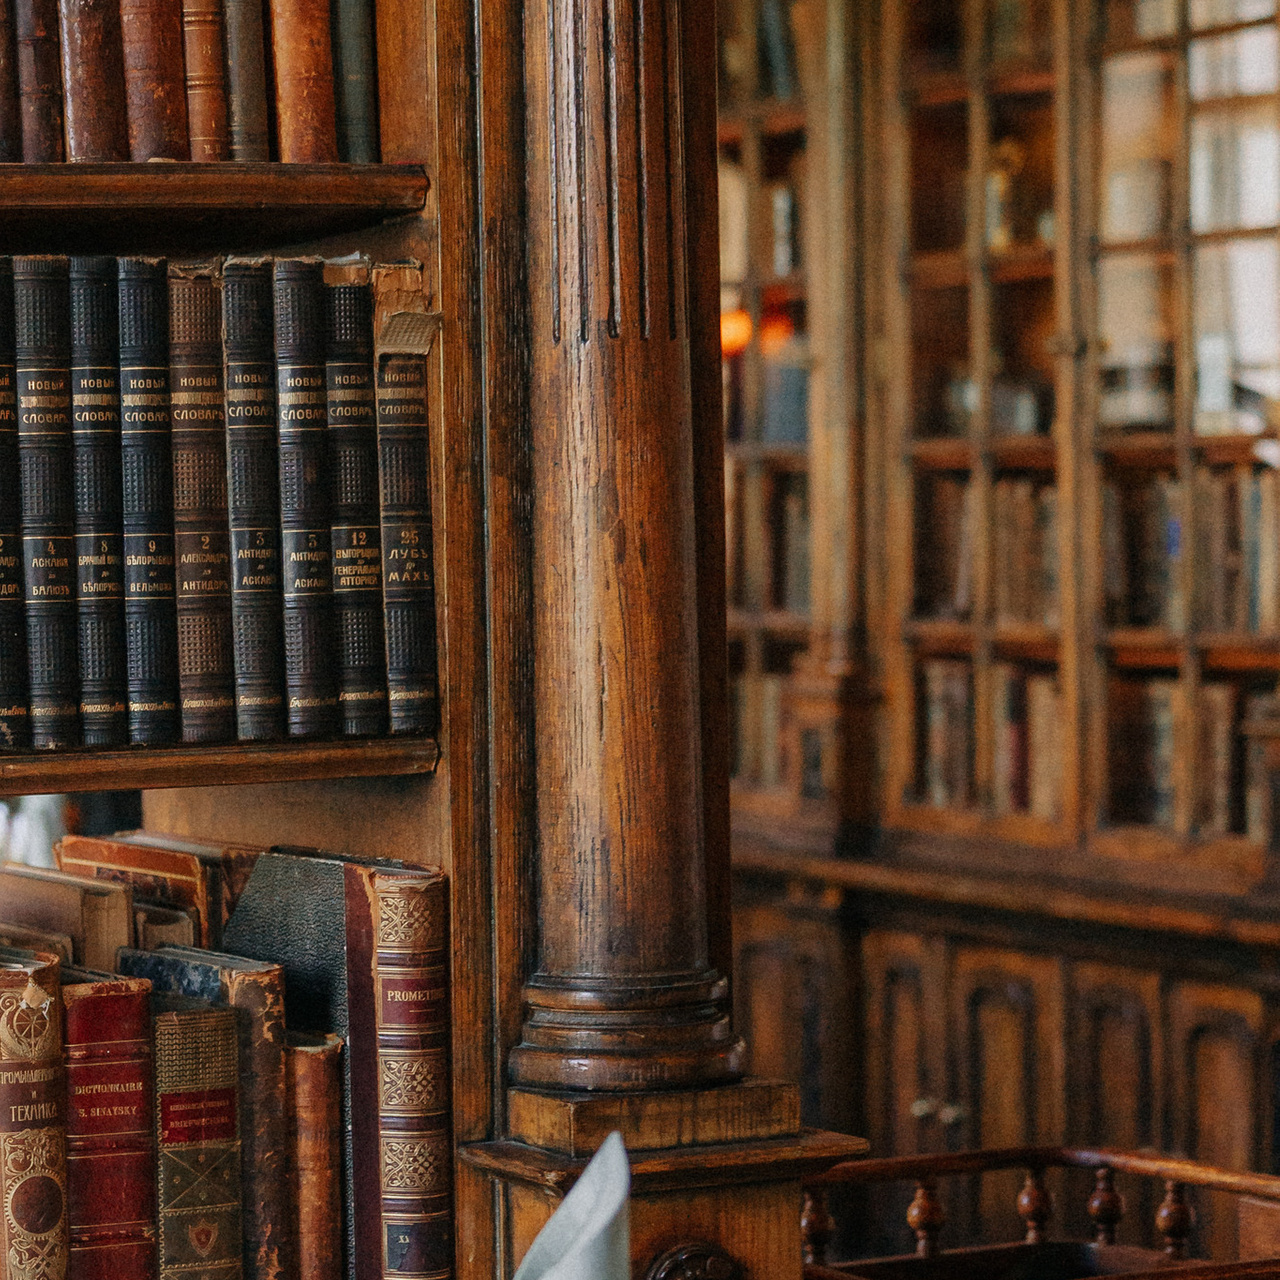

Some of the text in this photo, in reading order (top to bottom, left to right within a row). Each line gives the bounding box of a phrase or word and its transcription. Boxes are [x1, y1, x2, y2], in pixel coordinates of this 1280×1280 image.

[28, 379, 64, 391] НОВЫЙ
[180, 375, 217, 387] НОВЫЙ
[174, 409, 225, 420] СЛОВАРЬ
[201, 535, 210, 550] 2
[256, 532, 265, 546] 3
[351, 532, 367, 546] 12
[401, 530, 419, 545] 25
[48, 541, 56, 555] 4
[101, 540, 108, 553] 8
[148, 540, 156, 553] 9
[32, 585, 70, 596] БАЛЮЗЪ
[75, 1082, 143, 1095] DICTIONNAIRE
[9, 1102, 58, 1122] ТЕХНИКА
[90, 1106, 137, 1117] SINAYSKY
